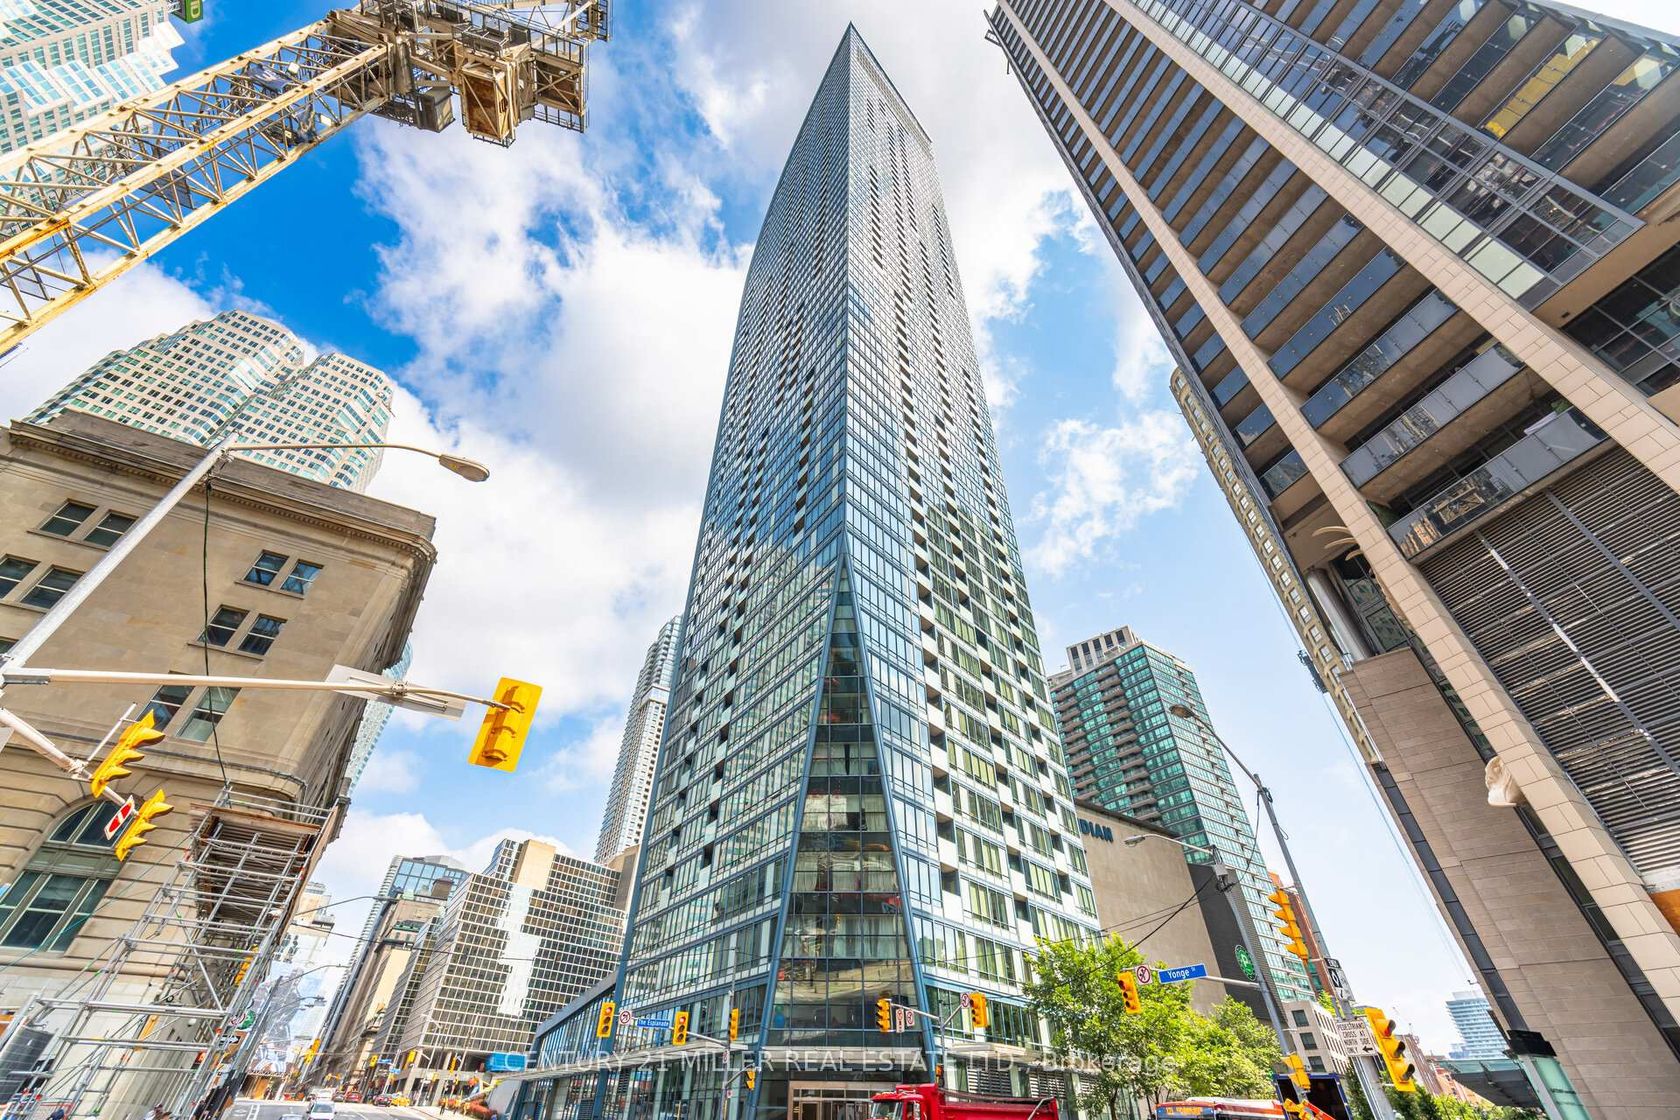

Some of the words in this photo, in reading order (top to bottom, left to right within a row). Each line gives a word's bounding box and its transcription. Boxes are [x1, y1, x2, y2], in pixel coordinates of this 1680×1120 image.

[1167, 969, 1190, 980] Yonge
[647, 1018, 669, 1027] Esplanade
[1336, 1022, 1365, 1031] PEDESTRIANS
[1342, 1031, 1358, 1039] CROSS
[1344, 1038, 1359, 1046] NORTH
[1346, 1047, 1359, 1055] ONLY
